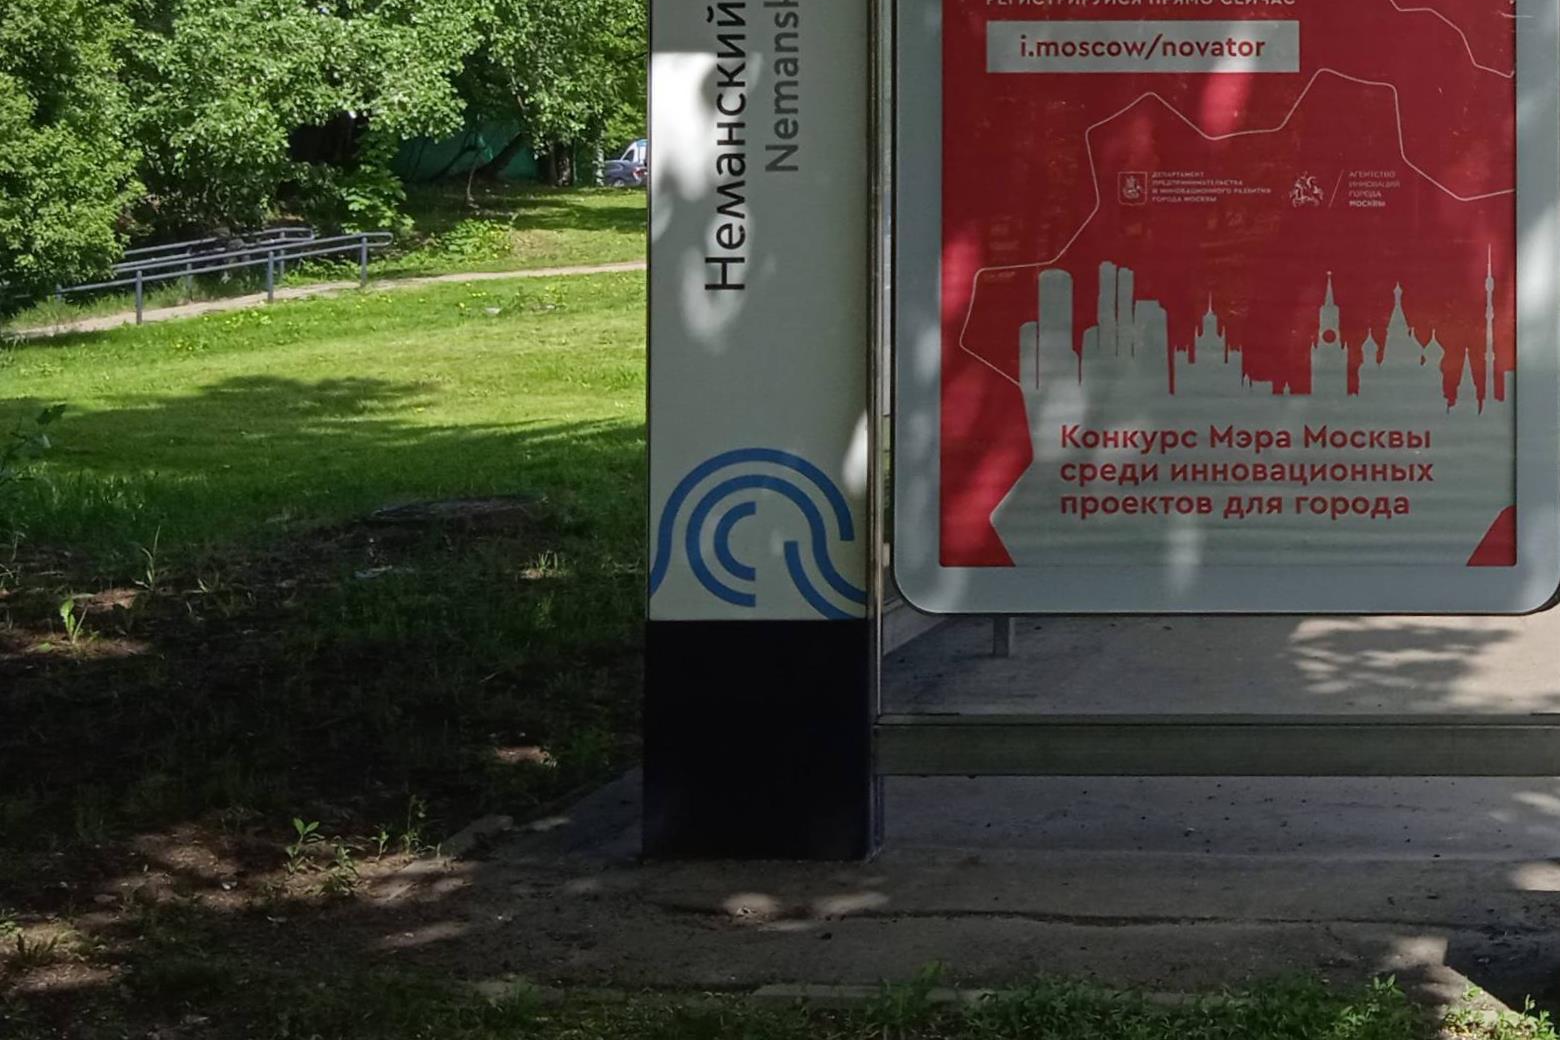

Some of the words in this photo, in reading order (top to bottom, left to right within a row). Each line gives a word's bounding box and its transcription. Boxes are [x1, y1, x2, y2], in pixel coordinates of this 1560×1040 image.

[1019, 32, 1267, 64] i.moscow/novator
[704, 2, 749, 291] Неманский
[1060, 424, 1198, 455] Конкурс
[1210, 424, 1292, 454] Мэра
[1304, 425, 1431, 450] Москвы
[1060, 462, 1161, 486] среди
[1169, 462, 1434, 484] инновационных
[1060, 495, 1213, 520] проектов
[1223, 496, 1282, 519] для
[1294, 494, 1410, 520] города
